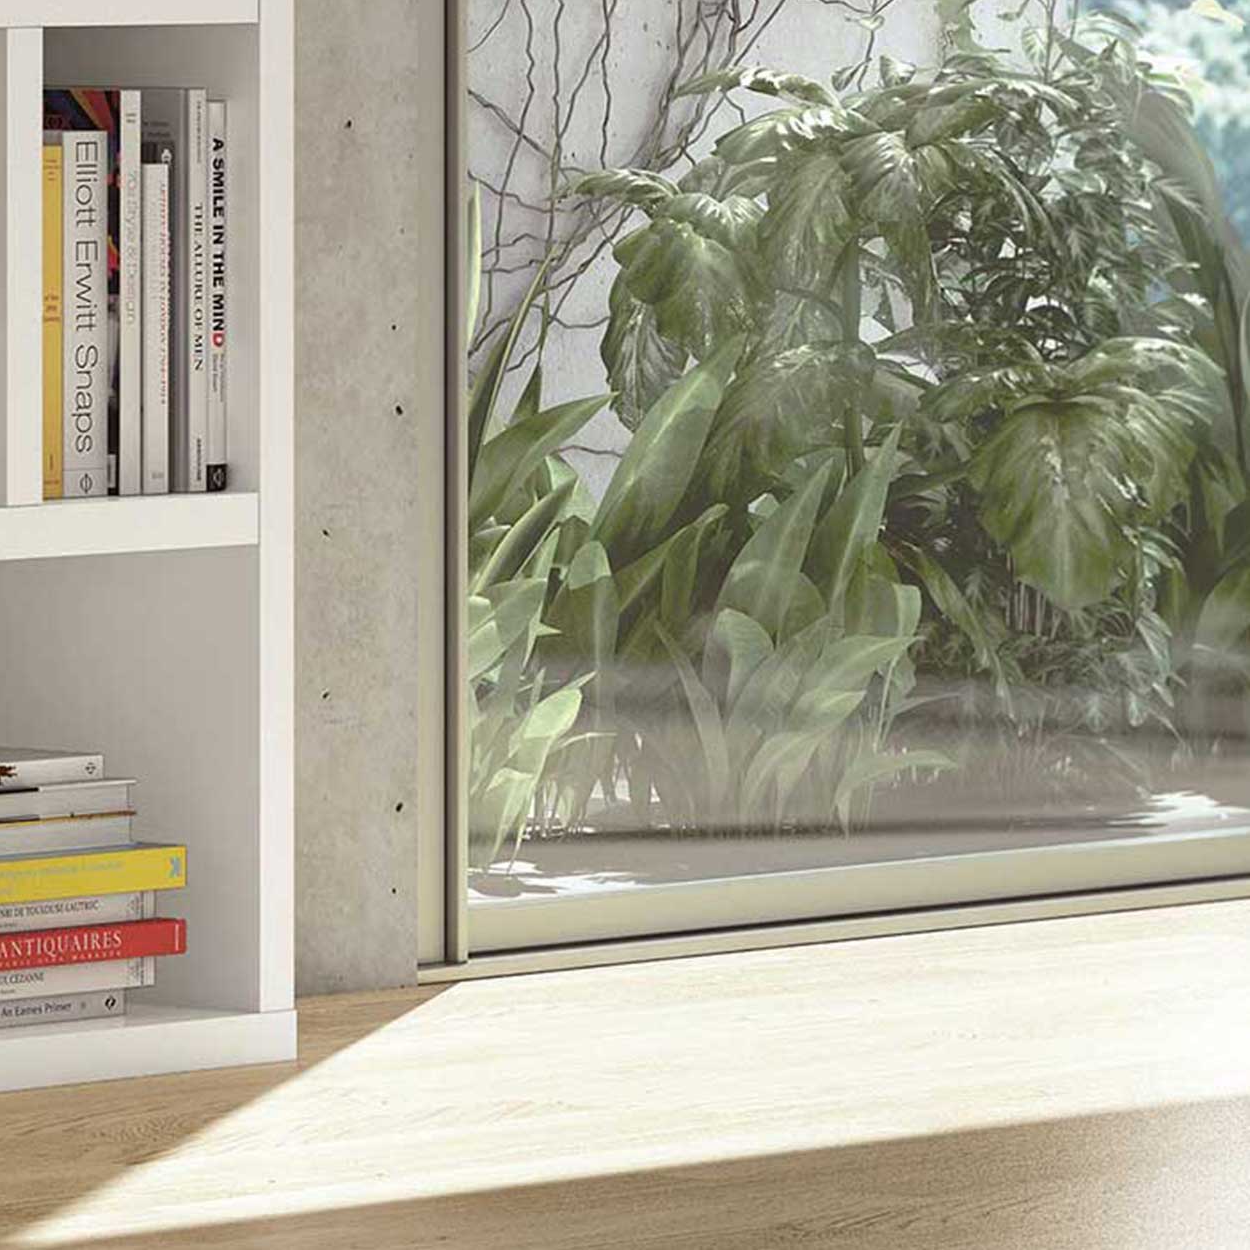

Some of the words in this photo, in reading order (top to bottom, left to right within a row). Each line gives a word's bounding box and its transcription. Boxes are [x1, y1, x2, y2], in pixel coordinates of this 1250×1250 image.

[212, 138, 224, 152] A
[75, 141, 97, 226] Elliott
[212, 158, 224, 218] SMILE
[194, 203, 203, 233] THE
[212, 225, 224, 245] IN
[75, 240, 98, 331] Erwitt
[194, 243, 203, 300] ALLURE
[212, 251, 224, 288] THE
[194, 307, 203, 328] OF
[212, 294, 224, 348] MIND
[194, 334, 203, 371] MEN
[71, 344, 98, 453] Snaps
[14, 907, 24, 918] DE
[0, 930, 122, 959] ANTIQUAIRES
[0, 1008, 13, 1018] An
[15, 1006, 43, 1016] Eames
[45, 1002, 72, 1014] Primer
